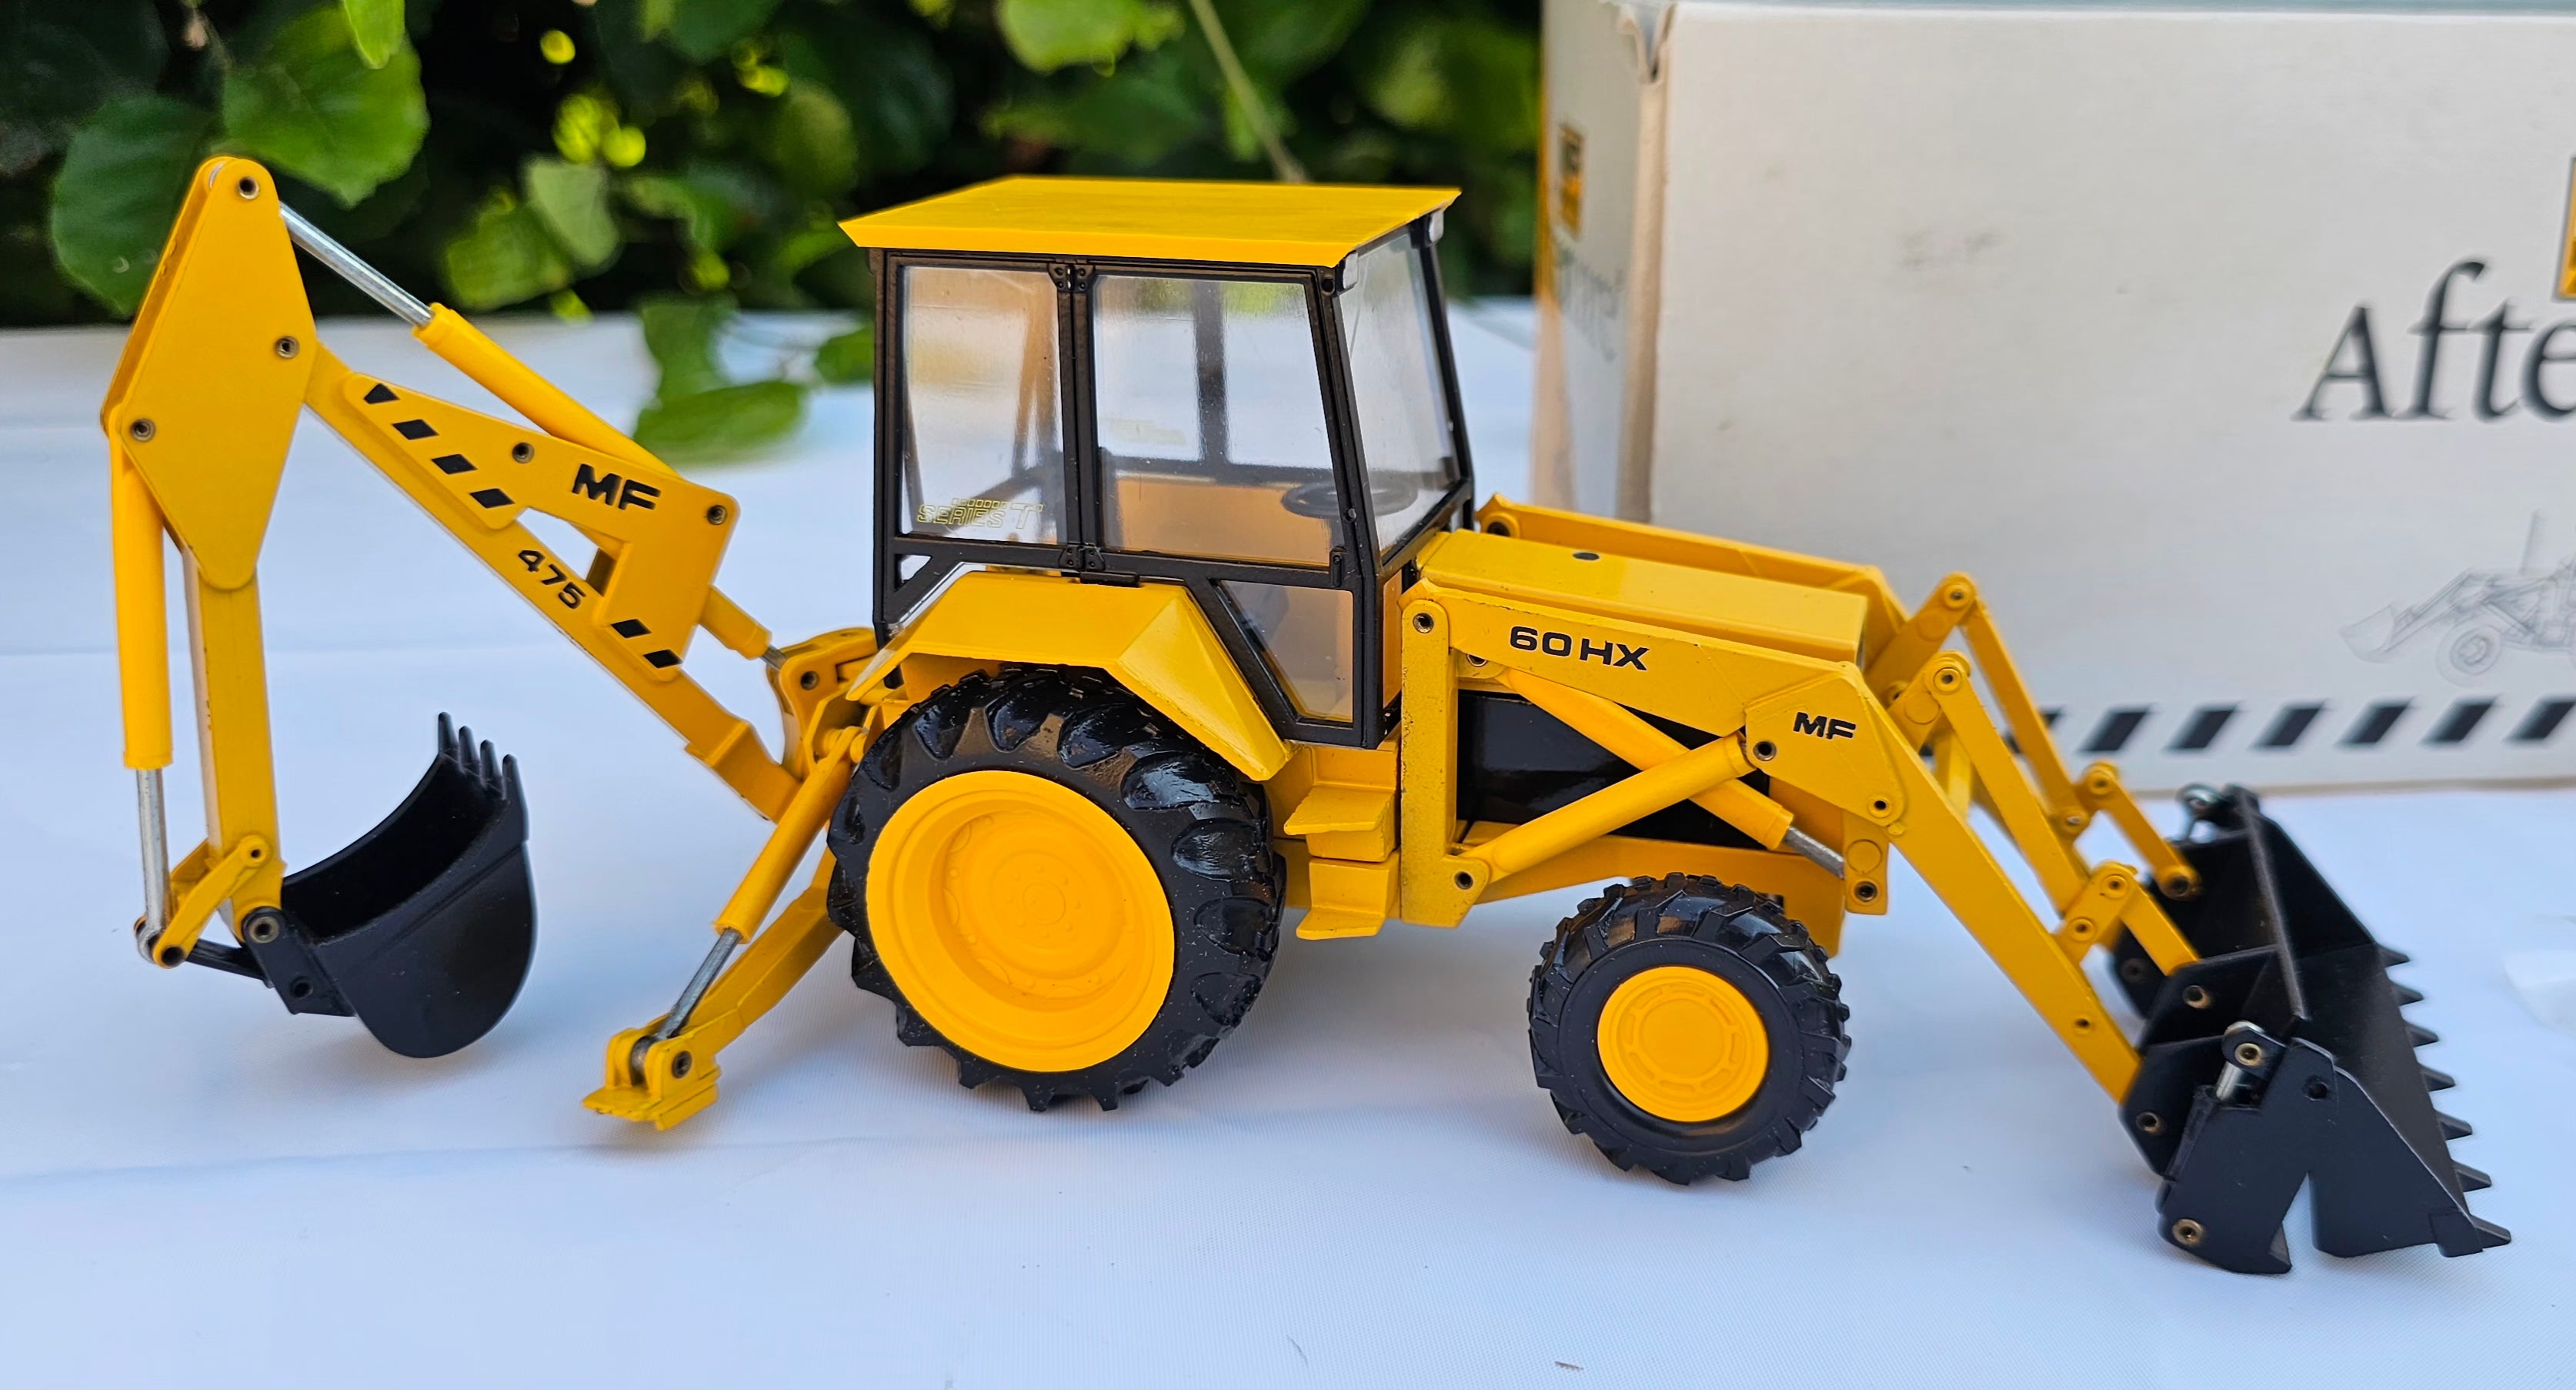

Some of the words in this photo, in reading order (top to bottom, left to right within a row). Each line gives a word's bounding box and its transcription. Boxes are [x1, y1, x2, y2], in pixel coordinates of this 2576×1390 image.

[572, 463, 661, 510] MF
[917, 504, 1006, 529] SERIES
[518, 550, 586, 609] 475
[1793, 712, 1857, 740] MF
